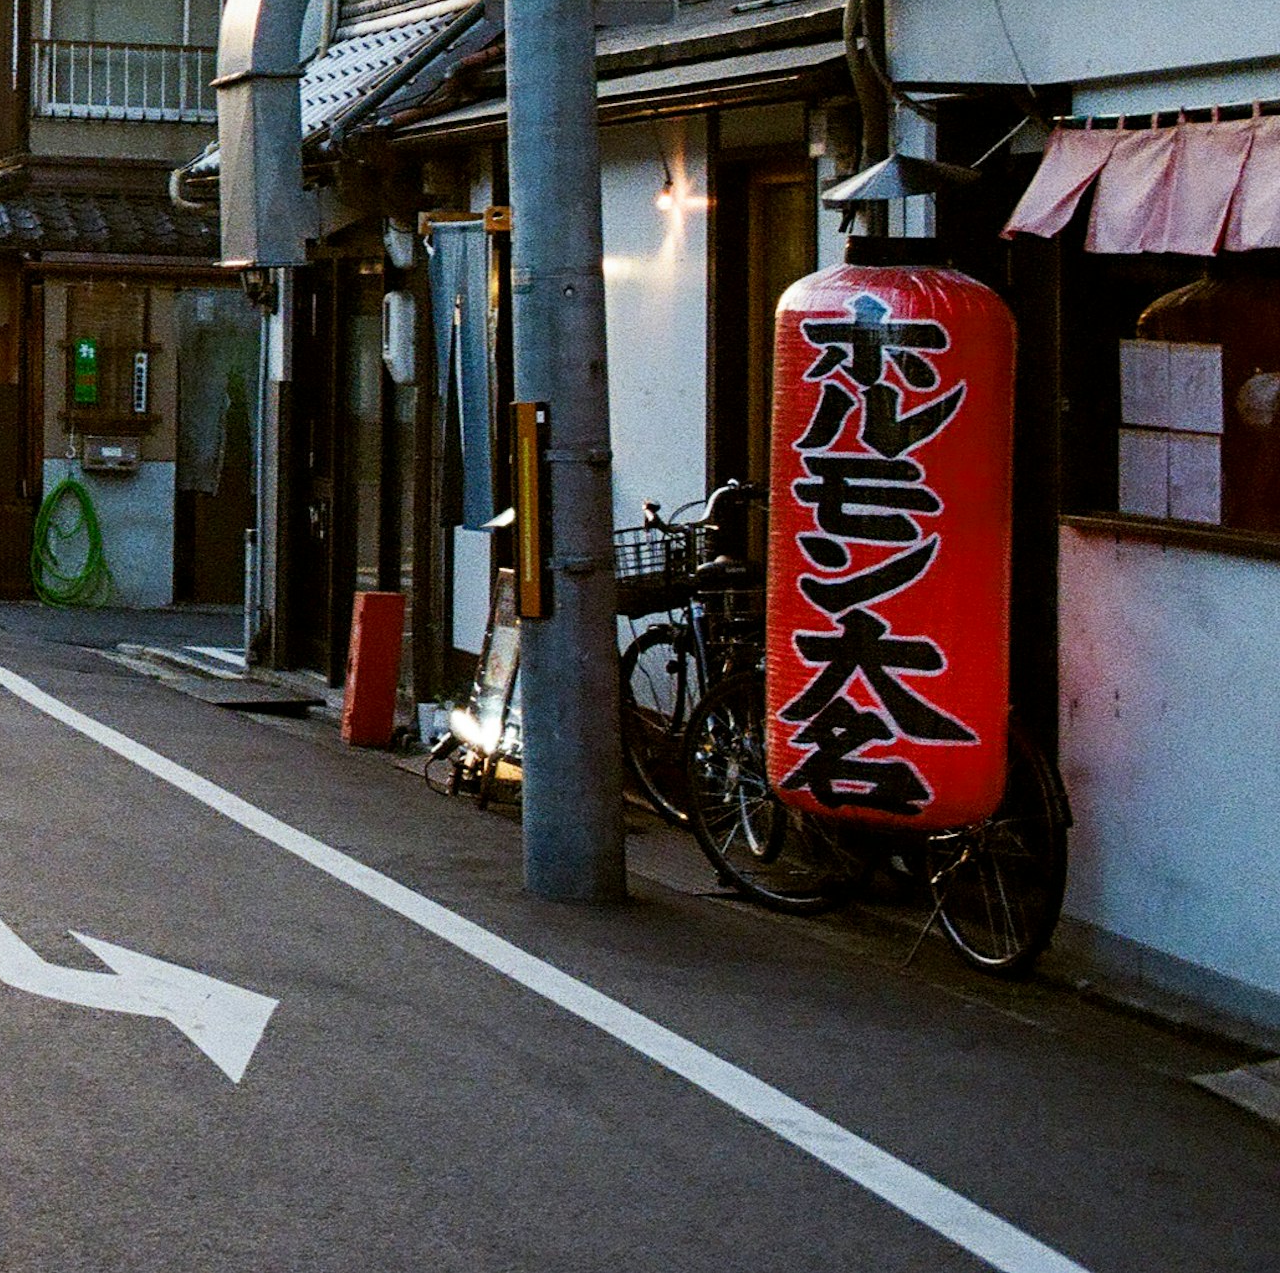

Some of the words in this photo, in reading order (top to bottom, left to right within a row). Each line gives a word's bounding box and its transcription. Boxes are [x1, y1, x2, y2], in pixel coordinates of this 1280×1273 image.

[776, 293, 981, 815] ホルモン大名
